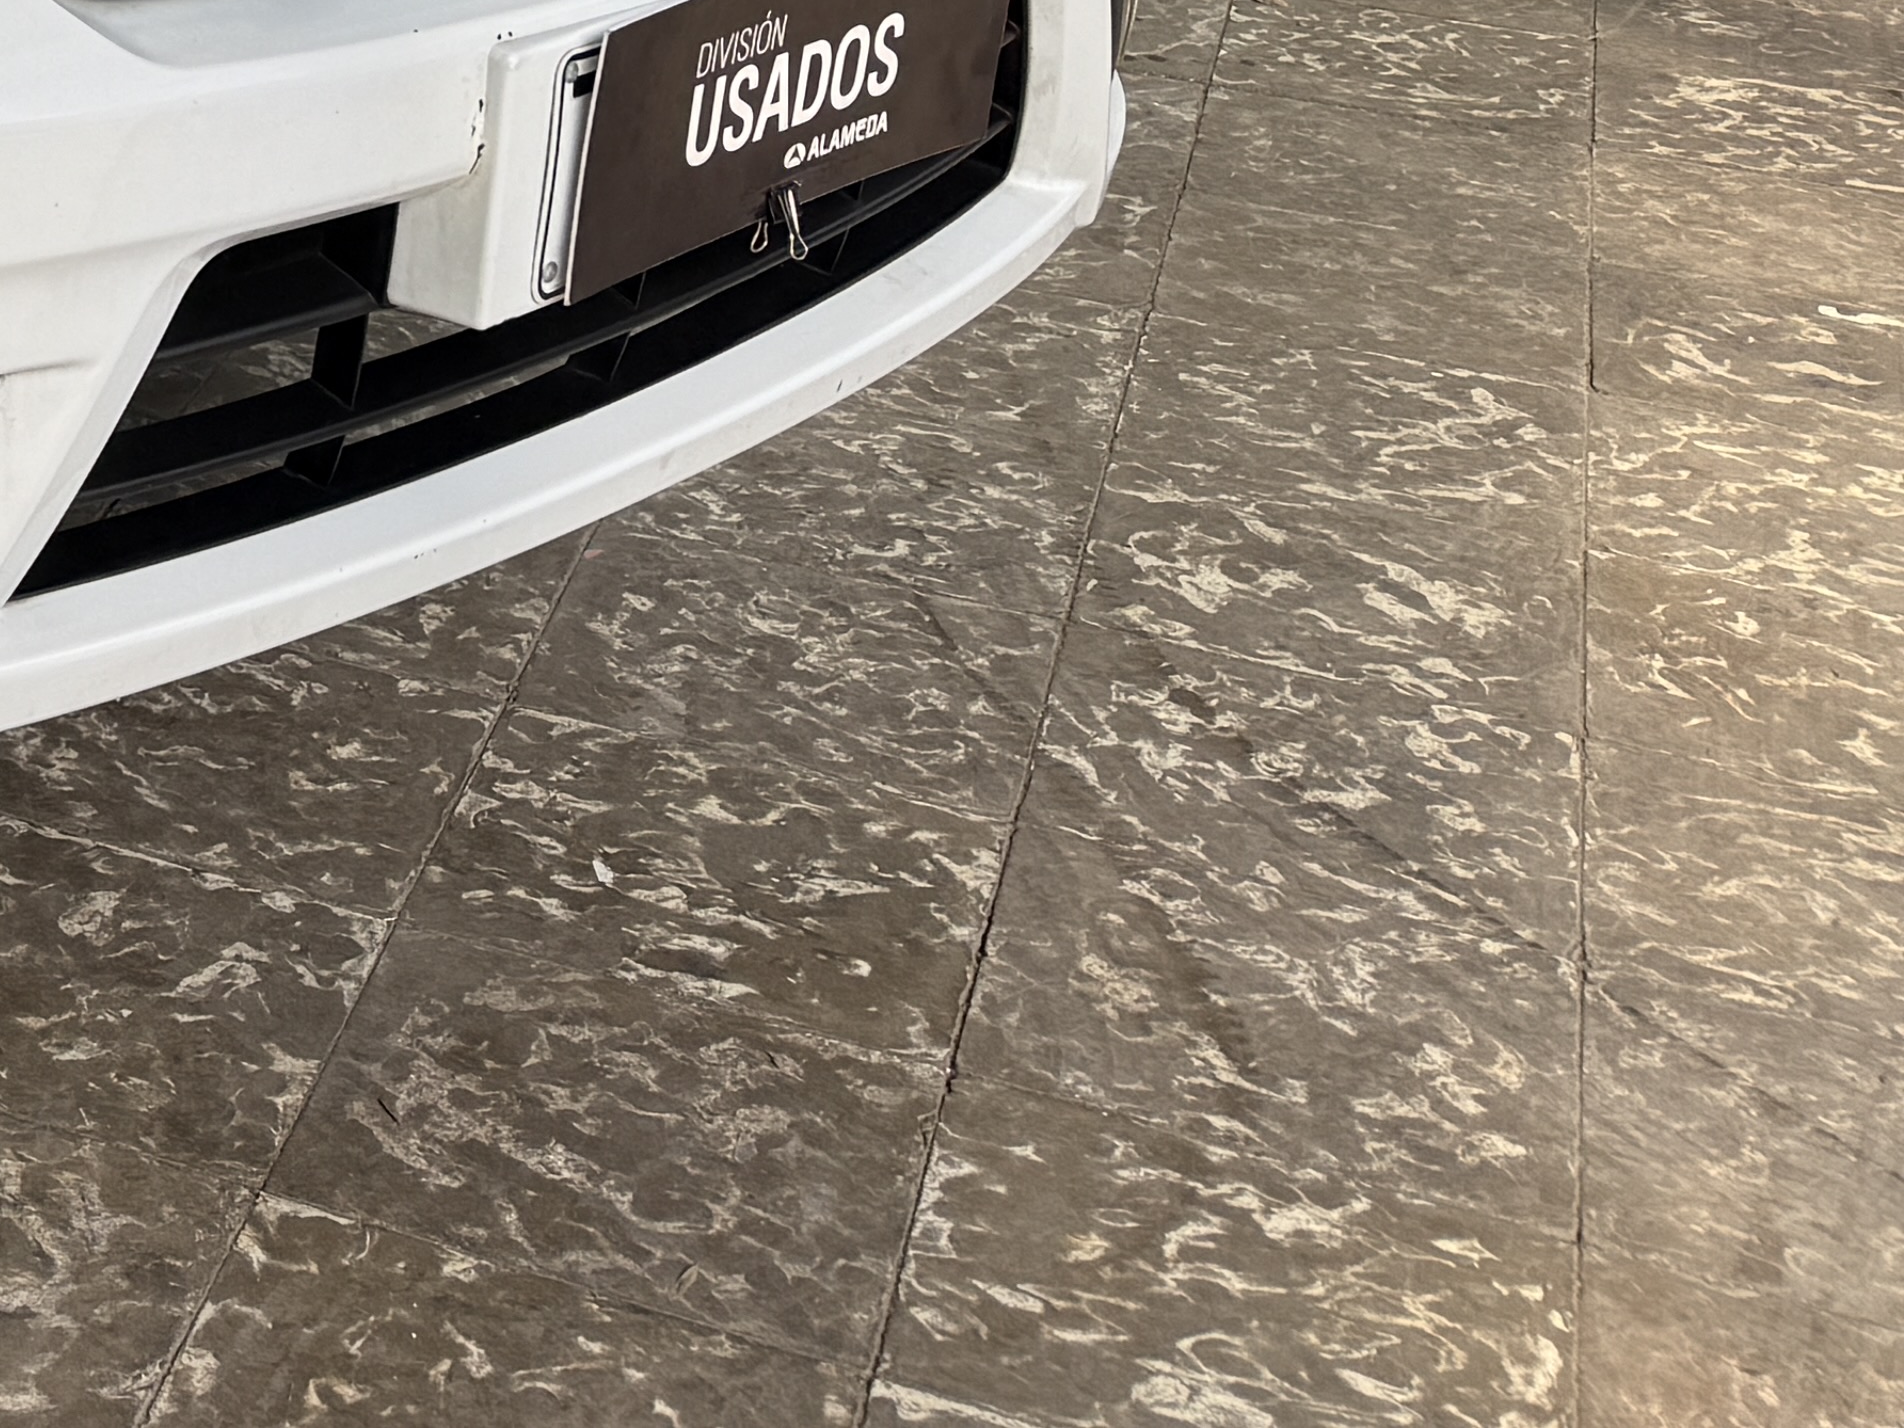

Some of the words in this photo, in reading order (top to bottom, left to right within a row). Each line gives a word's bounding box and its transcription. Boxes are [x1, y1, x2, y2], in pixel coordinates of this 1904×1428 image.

[696, 10, 789, 80] DIVISIÓN
[685, 12, 905, 168] USADOS
[807, 111, 889, 162] ALAMEDA
